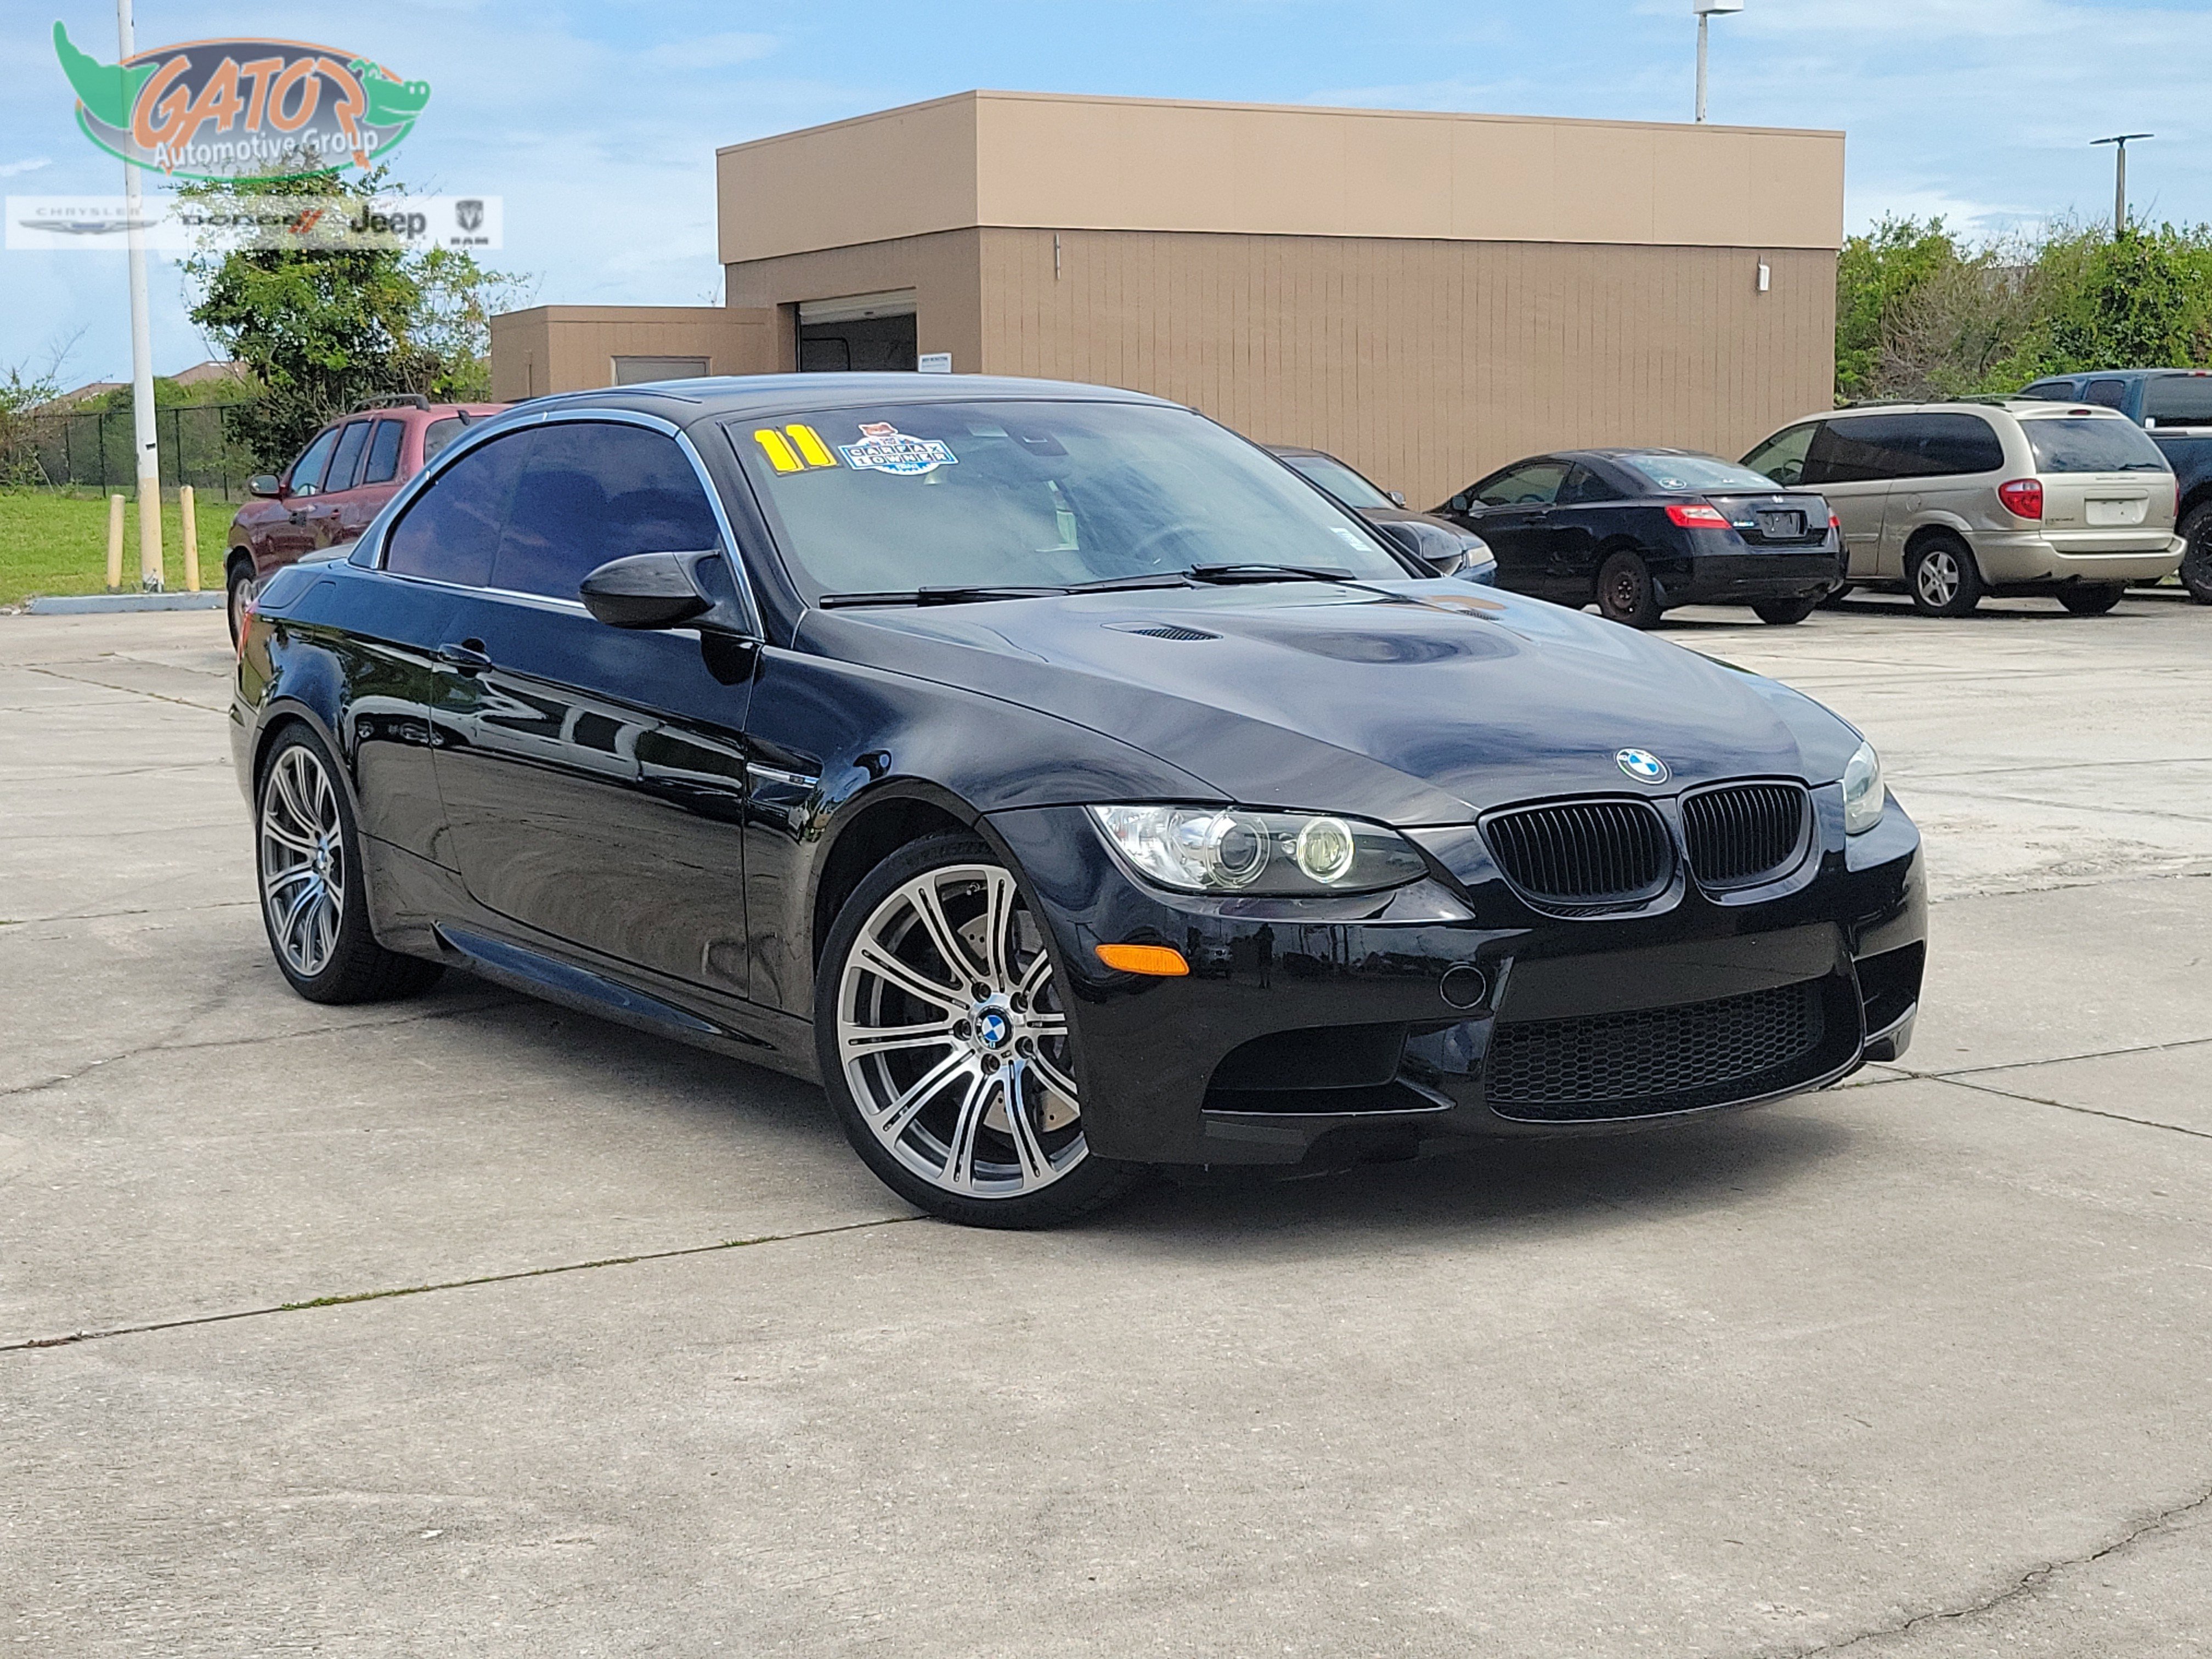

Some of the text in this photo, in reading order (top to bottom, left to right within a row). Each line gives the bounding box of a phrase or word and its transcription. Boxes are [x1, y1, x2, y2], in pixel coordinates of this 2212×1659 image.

[754, 424, 838, 473] 11
[849, 444, 943, 456] CARFAX
[870, 453, 948, 464] OWNER
